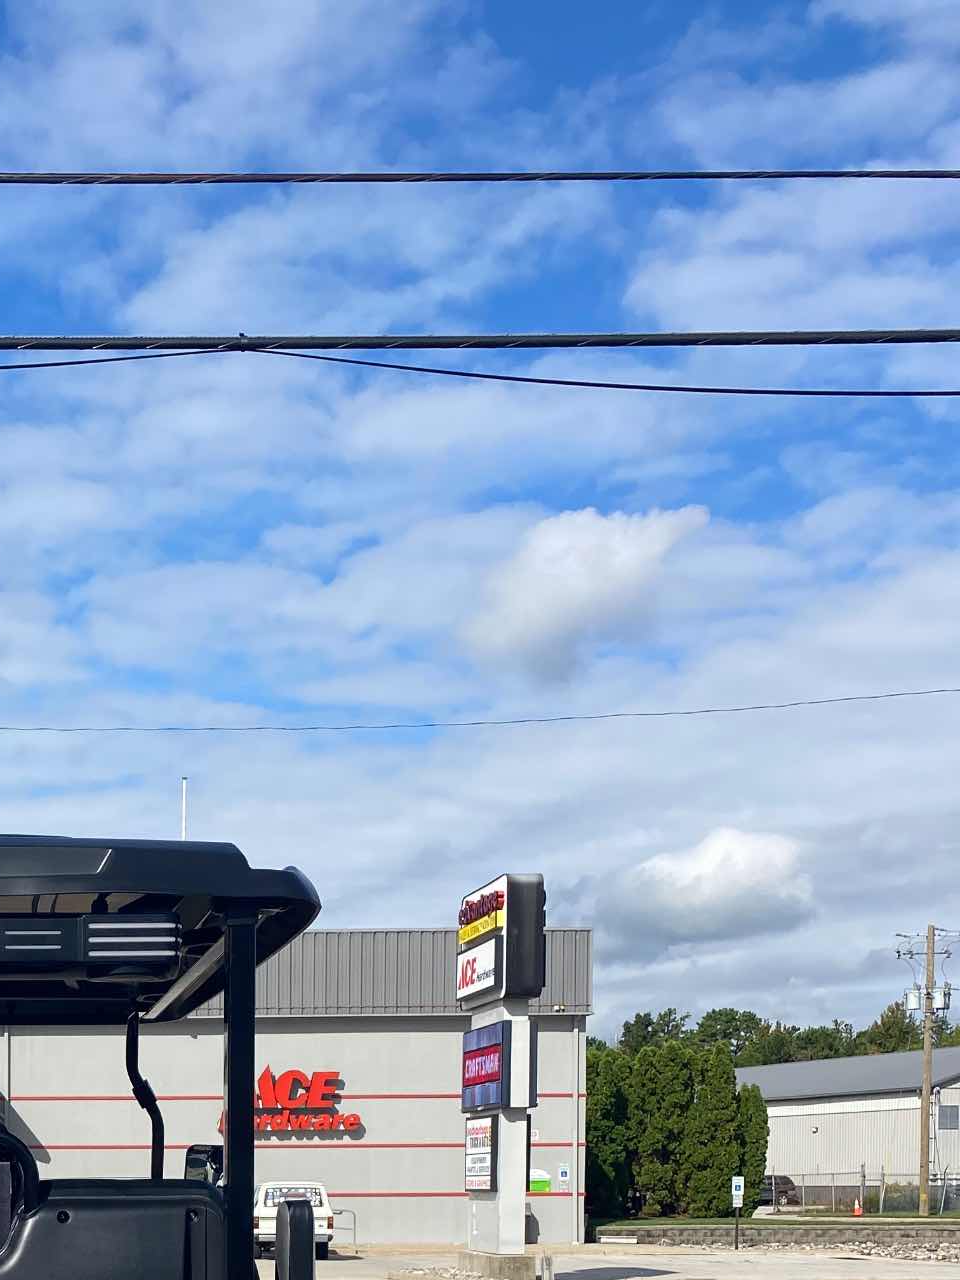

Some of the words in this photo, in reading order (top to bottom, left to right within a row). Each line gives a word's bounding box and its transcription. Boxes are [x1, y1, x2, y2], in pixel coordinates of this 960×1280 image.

[458, 957, 477, 990] ACE
[464, 1052, 499, 1079] CRAFTSMAN
[218, 1109, 361, 1134] rdware
